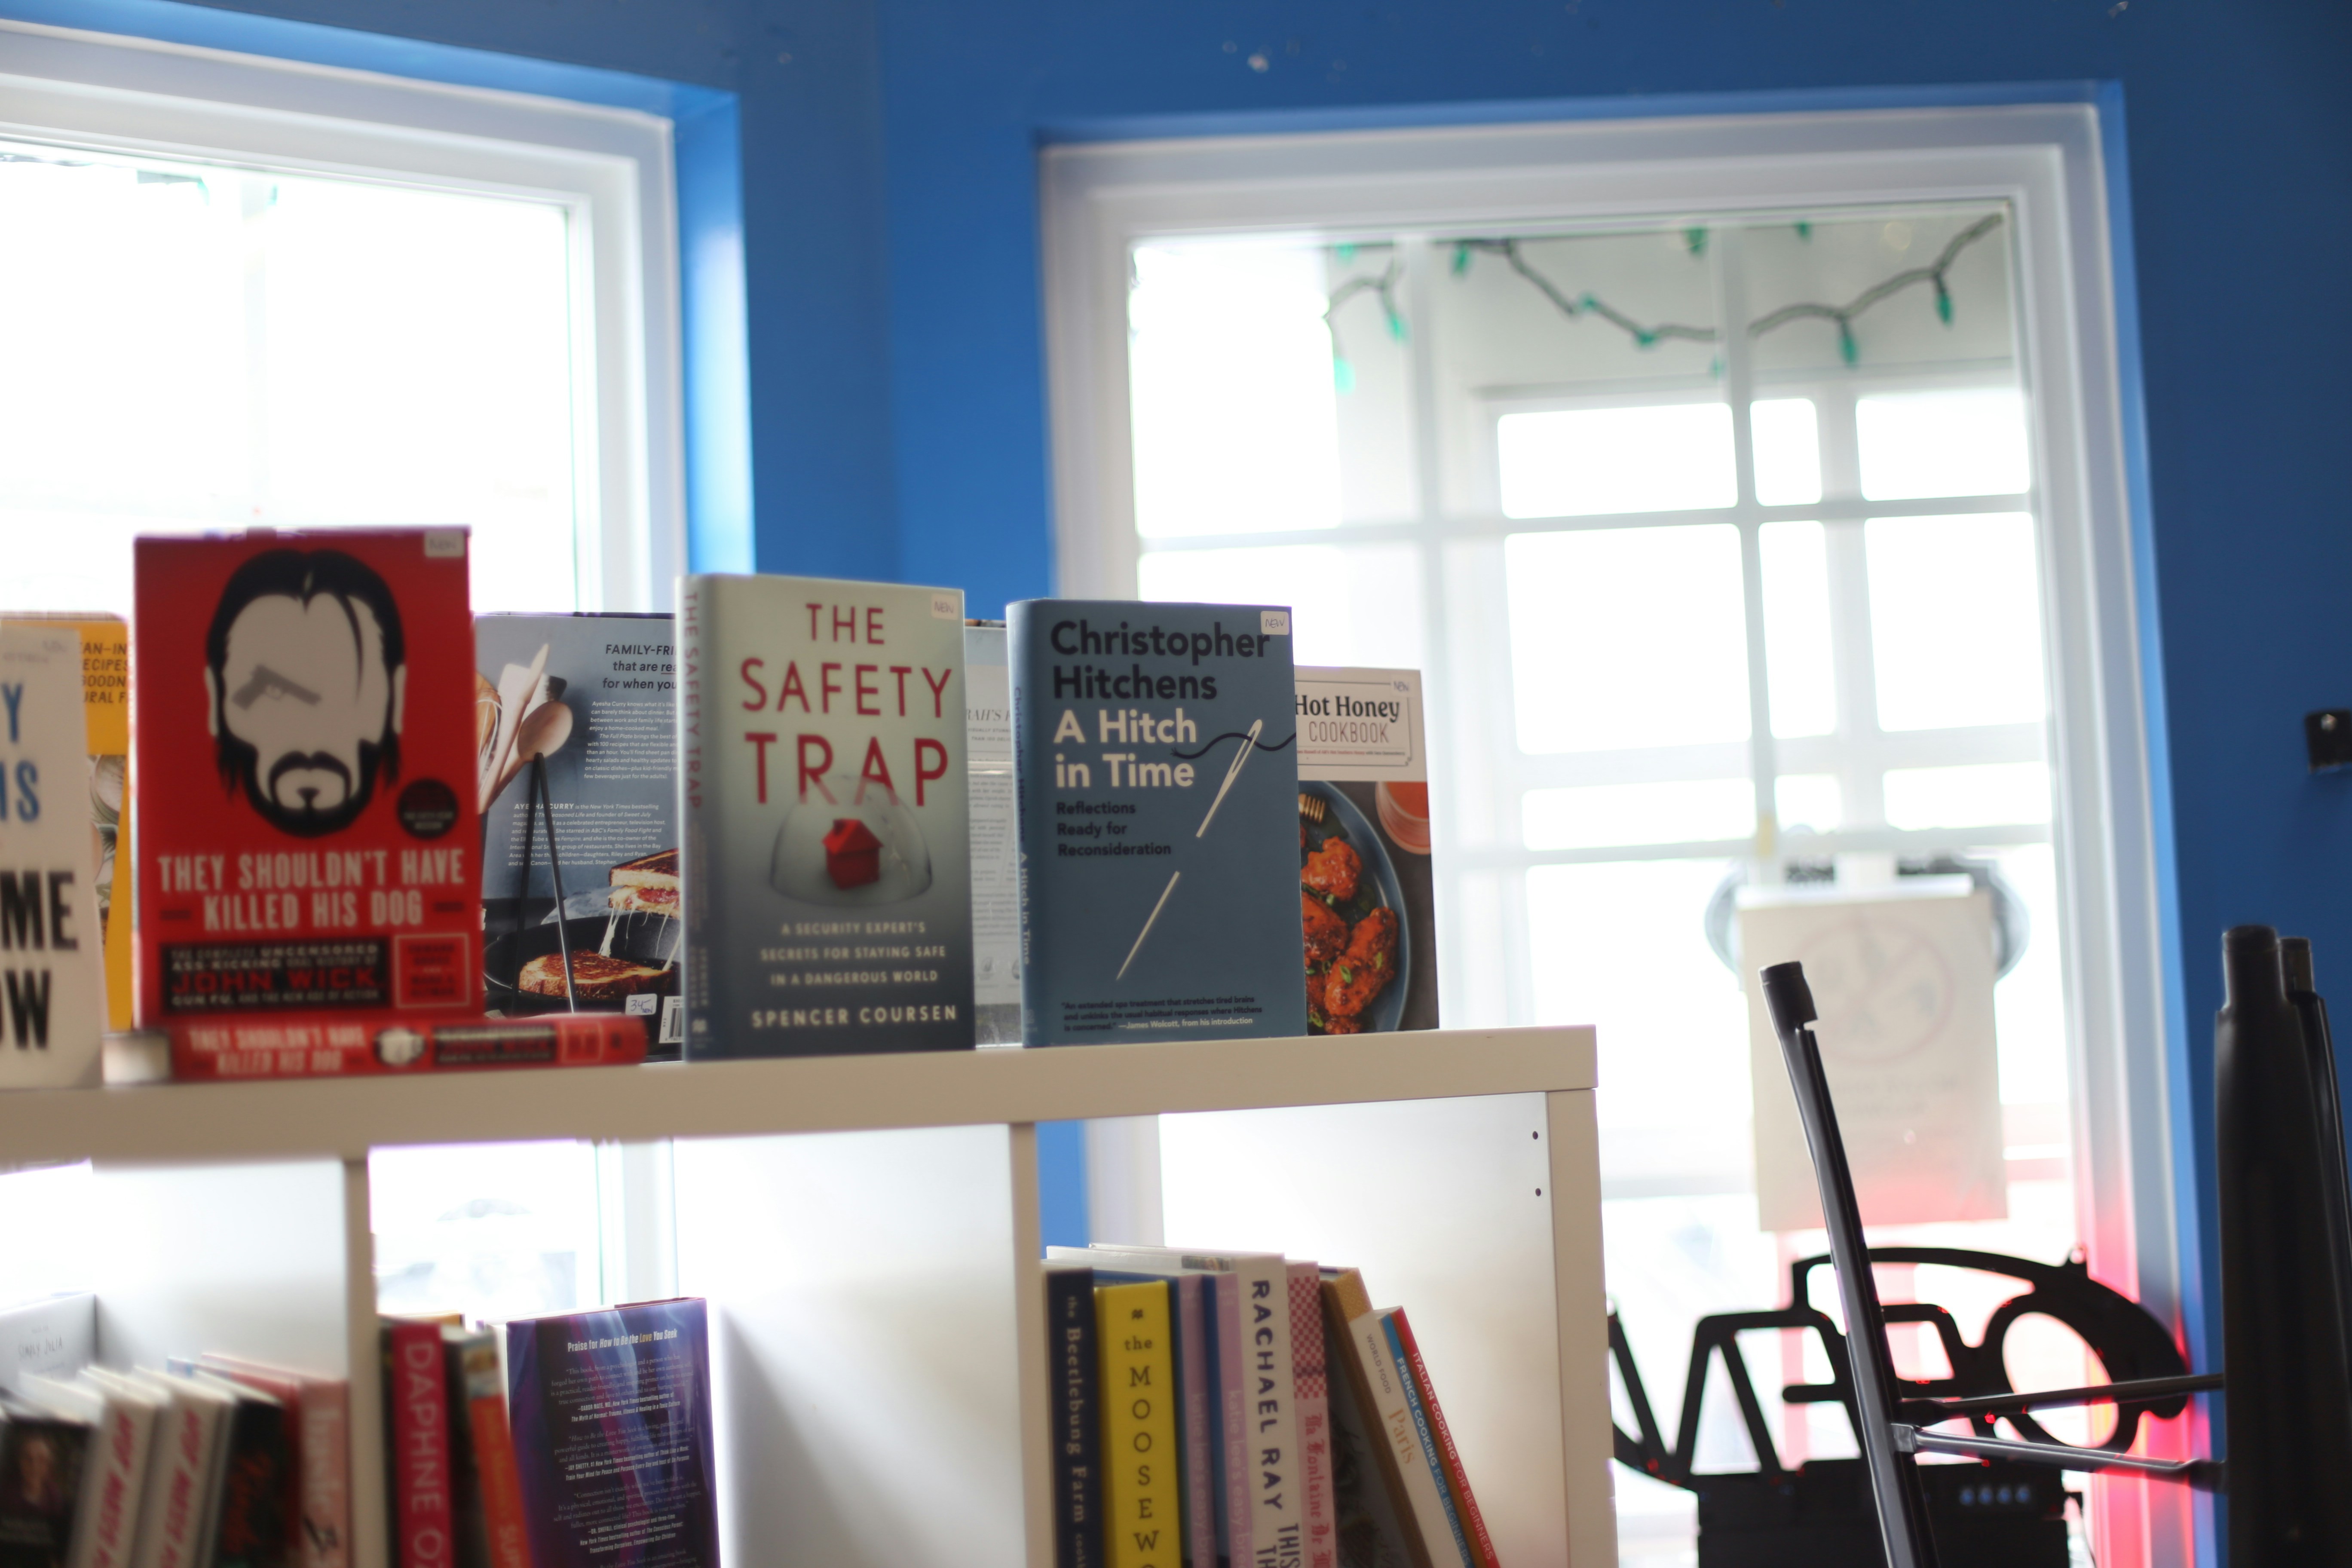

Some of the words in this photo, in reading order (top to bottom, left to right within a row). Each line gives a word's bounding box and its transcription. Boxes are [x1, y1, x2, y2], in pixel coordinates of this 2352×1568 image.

[685, 593, 698, 637] THE
[806, 603, 885, 644] THE
[1265, 616, 1285, 628] NEW
[80, 642, 127, 655] AN-IN
[606, 644, 676, 655] FAMILY-FRI
[1050, 619, 1270, 666] Christopher
[603, 677, 620, 688] for
[623, 678, 654, 689] when
[613, 660, 637, 671] that
[1054, 665, 1217, 700] Hitchens
[685, 647, 700, 736] SAFETY
[741, 658, 952, 718] SAFETY
[1054, 710, 1086, 743] A
[1099, 708, 1197, 743] Hitch
[1295, 695, 1330, 716] Hot
[1335, 696, 1399, 723] Honey
[1014, 687, 1023, 773] Christopher
[1309, 721, 1389, 743] COOKBOOK
[687, 747, 702, 808] TRAP
[745, 733, 948, 806] TRAP
[1056, 754, 1090, 788] in
[1103, 753, 1194, 787] Time
[1056, 802, 1136, 814] Reflections
[1057, 823, 1101, 838] Ready
[1107, 822, 1127, 835] for
[1058, 843, 1171, 856] Reconsideration
[158, 855, 225, 892] THEY
[239, 850, 388, 889] SHOULDN'T
[401, 849, 465, 885] HAVE
[204, 893, 299, 931] KILLED
[312, 892, 357, 928] HIS
[371, 890, 423, 926] DOG
[781, 924, 790, 935] A
[795, 923, 860, 935] SECURITY
[866, 922, 926, 934] EXPERT'S
[1023, 911, 1029, 924] in
[760, 948, 818, 961] SECRETS
[824, 948, 849, 959] FOR
[855, 946, 910, 959] STAYING
[916, 946, 945, 957] SAFE
[173, 970, 271, 993] JOHN
[771, 974, 785, 986] IN
[791, 974, 799, 985] A
[805, 971, 887, 985] DANGEROUS
[893, 970, 938, 982] WORLD
[0, 970, 51, 1050] W
[751, 1008, 849, 1028] SPENCER
[859, 1005, 957, 1023] COURSEN
[1078, 1001, 1113, 1009] extended
[1183, 997, 1214, 1005] stretches
[1150, 1020, 1180, 1028] Wolcott,
[1211, 1017, 1253, 1025] introduction
[568, 1341, 587, 1352] Praise
[589, 1340, 598, 1349] for
[600, 1338, 612, 1349] How
[613, 1338, 619, 1346] to
[621, 1335, 628, 1345] Be
[629, 1334, 639, 1344] the
[640, 1333, 652, 1343] Love
[653, 1331, 664, 1341] You
[664, 1328, 678, 1339] Seek
[1124, 1336, 1153, 1351] the
[1252, 1280, 1278, 1433] RACHAEL
[1367, 1334, 1382, 1367] WORLD
[1378, 1368, 1392, 1394] FOOD
[1066, 1327, 1084, 1455] Beetlebung
[406, 1342, 442, 1514] DAPHNE
[1229, 1390, 1243, 1435] katie
[1388, 1407, 1415, 1464] Paris
[1413, 1352, 1435, 1401] ITALIAN
[1432, 1403, 1456, 1461] COOKING
[1453, 1461, 1467, 1488] FOR
[1464, 1489, 1494, 1560] BEGINNERS
[1128, 1365, 1160, 1568] MOOSEW
[1261, 1447, 1283, 1510] RAY
[1307, 1438, 1325, 1518] Fontaine
[1397, 1357, 1418, 1407] FRENCH
[1415, 1409, 1437, 1467] COOKING
[1434, 1469, 1447, 1495] FOR
[1443, 1496, 1471, 1568] BEGINNERS
[1072, 1466, 1087, 1522] Farm
[1278, 1522, 1301, 1568] THIS
